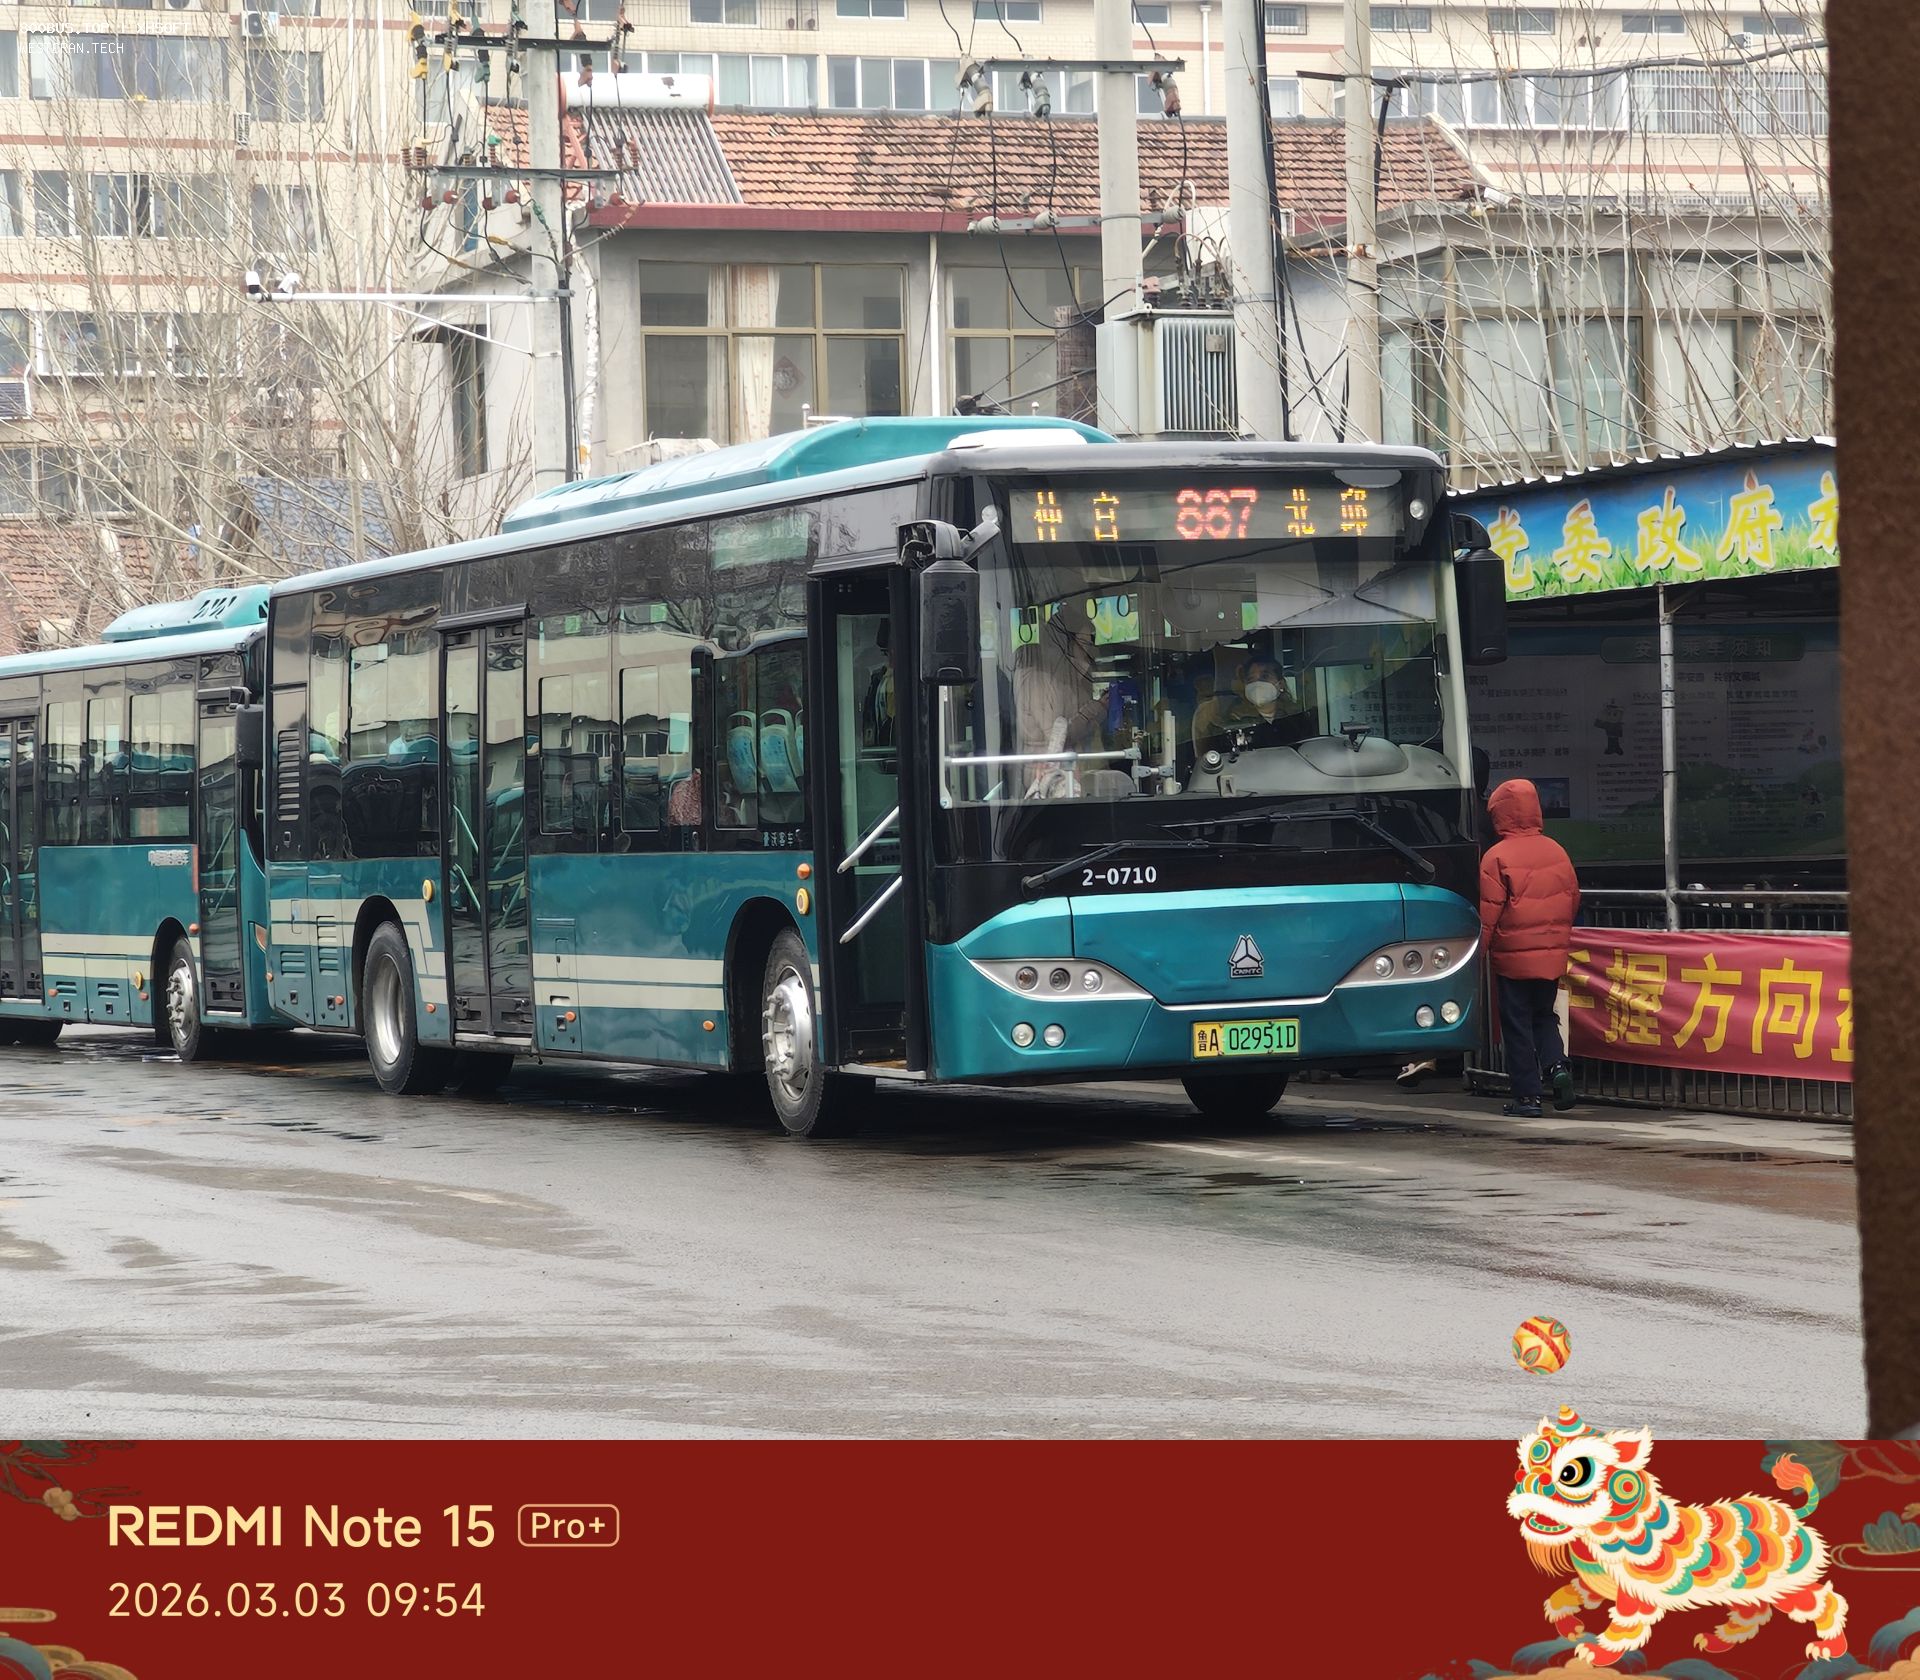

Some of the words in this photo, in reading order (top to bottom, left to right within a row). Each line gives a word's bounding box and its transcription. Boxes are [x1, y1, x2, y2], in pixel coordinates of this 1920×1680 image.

[1635, 639, 1772, 658] 安乘车须知
[1083, 867, 1156, 885] 2-0710
[1198, 1028, 1219, 1052] 鲁A
[1229, 1025, 1297, 1051] 02951D
